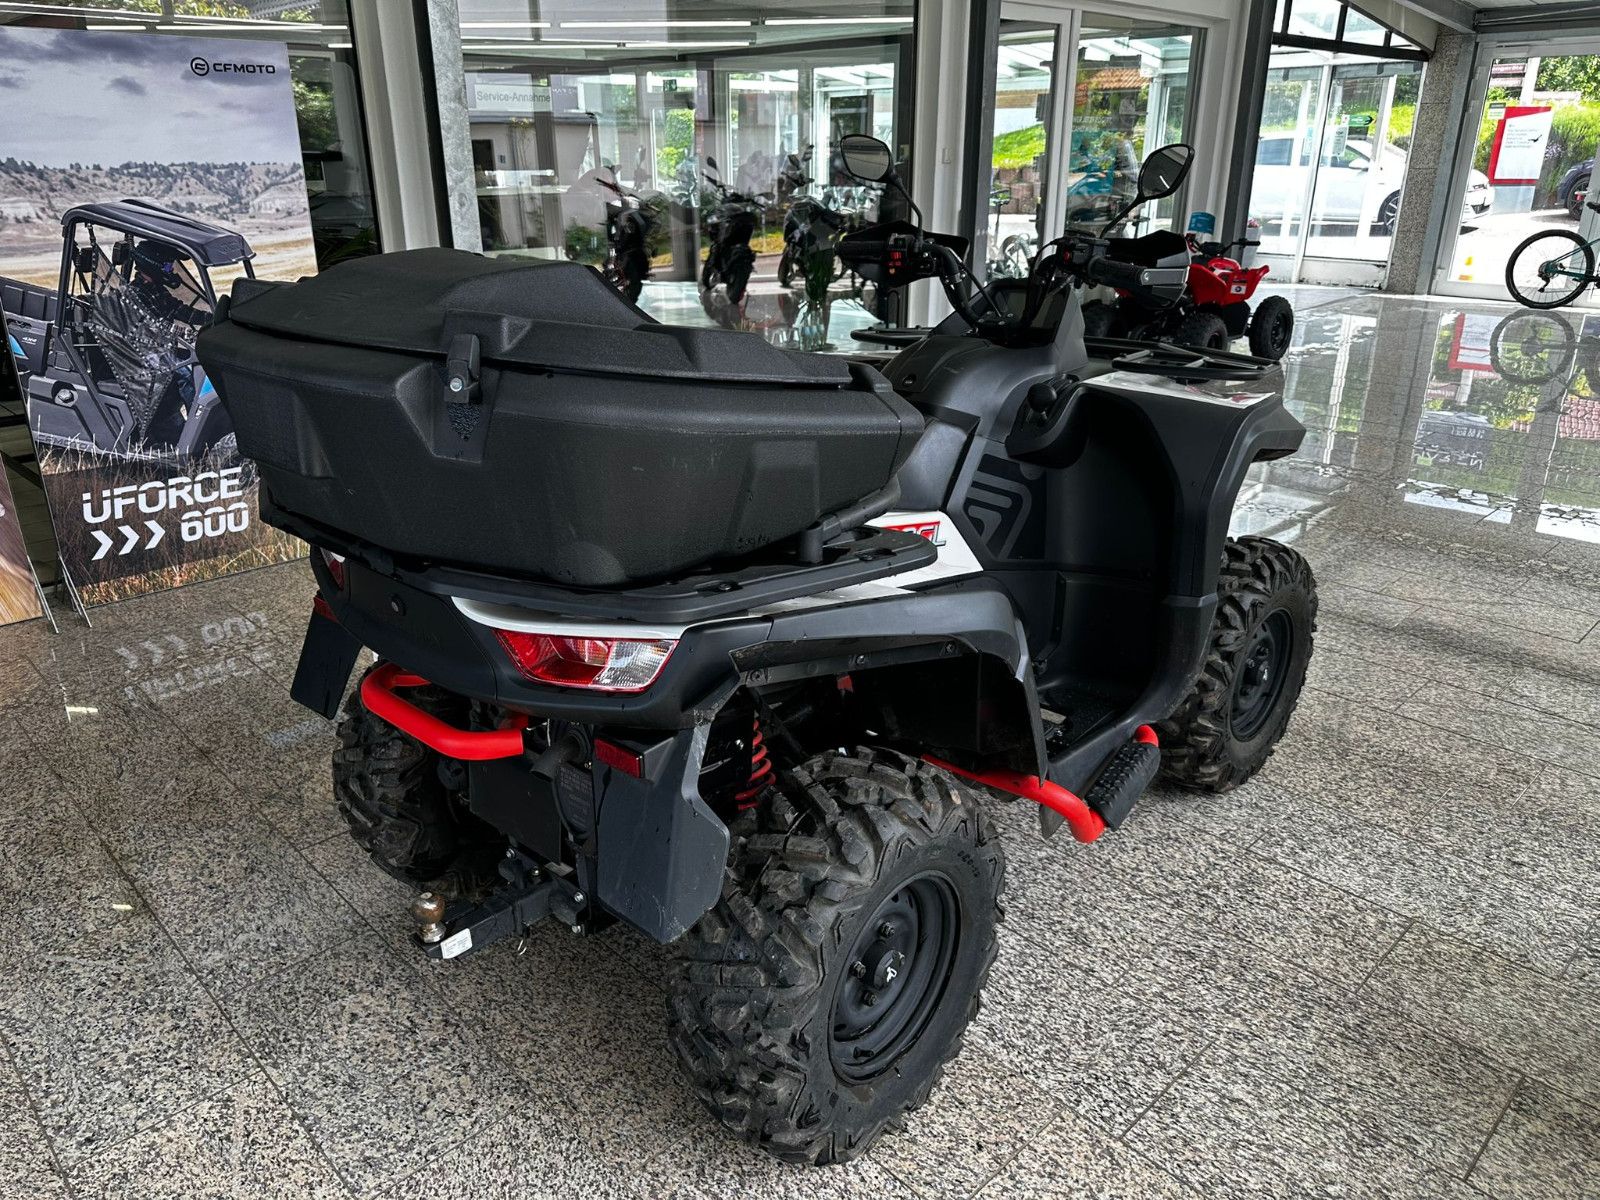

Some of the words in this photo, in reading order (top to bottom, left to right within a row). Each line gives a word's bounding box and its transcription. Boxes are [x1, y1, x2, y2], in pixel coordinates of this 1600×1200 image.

[212, 62, 276, 74] CFMOTO
[476, 90, 551, 103] Service-Annahme
[82, 467, 243, 524] UFORCE
[180, 501, 250, 542] 600
